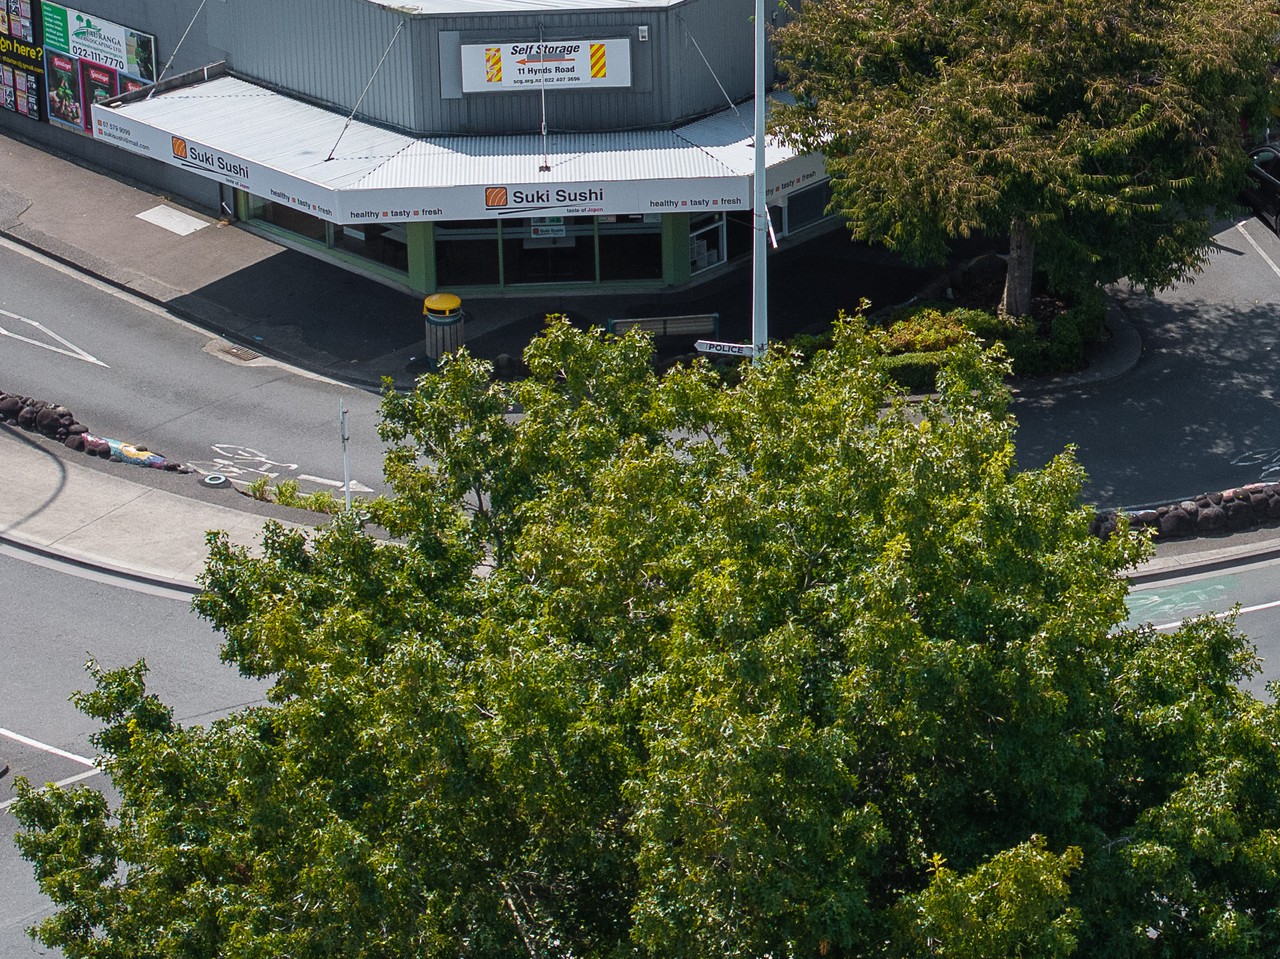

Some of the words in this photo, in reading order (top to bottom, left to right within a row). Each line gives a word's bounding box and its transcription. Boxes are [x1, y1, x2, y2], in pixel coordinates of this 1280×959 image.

[86, 29, 122, 47] TAURANGA
[14, 40, 43, 61] here?
[72, 45, 125, 70] 022-111-7770
[511, 44, 533, 55] Self
[535, 43, 580, 55] Storage
[517, 67, 525, 75] 11
[527, 66, 553, 76] Hynds
[555, 66, 575, 74] Road
[189, 147, 214, 167] Suki
[217, 157, 249, 179] Sushi
[781, 179, 795, 190] tasty
[802, 171, 816, 182] fresh
[270, 189, 290, 203] healthy
[297, 198, 311, 210] tasty
[317, 205, 333, 216] fresh
[512, 189, 550, 204] Suki
[555, 188, 603, 203] Sushi
[650, 199, 679, 209] healthy
[690, 198, 710, 208] tasty
[721, 197, 742, 205] fresh
[350, 209, 380, 219] healthy
[390, 209, 410, 218] tasty
[422, 208, 443, 216] fresh
[708, 343, 744, 354] POLICE
